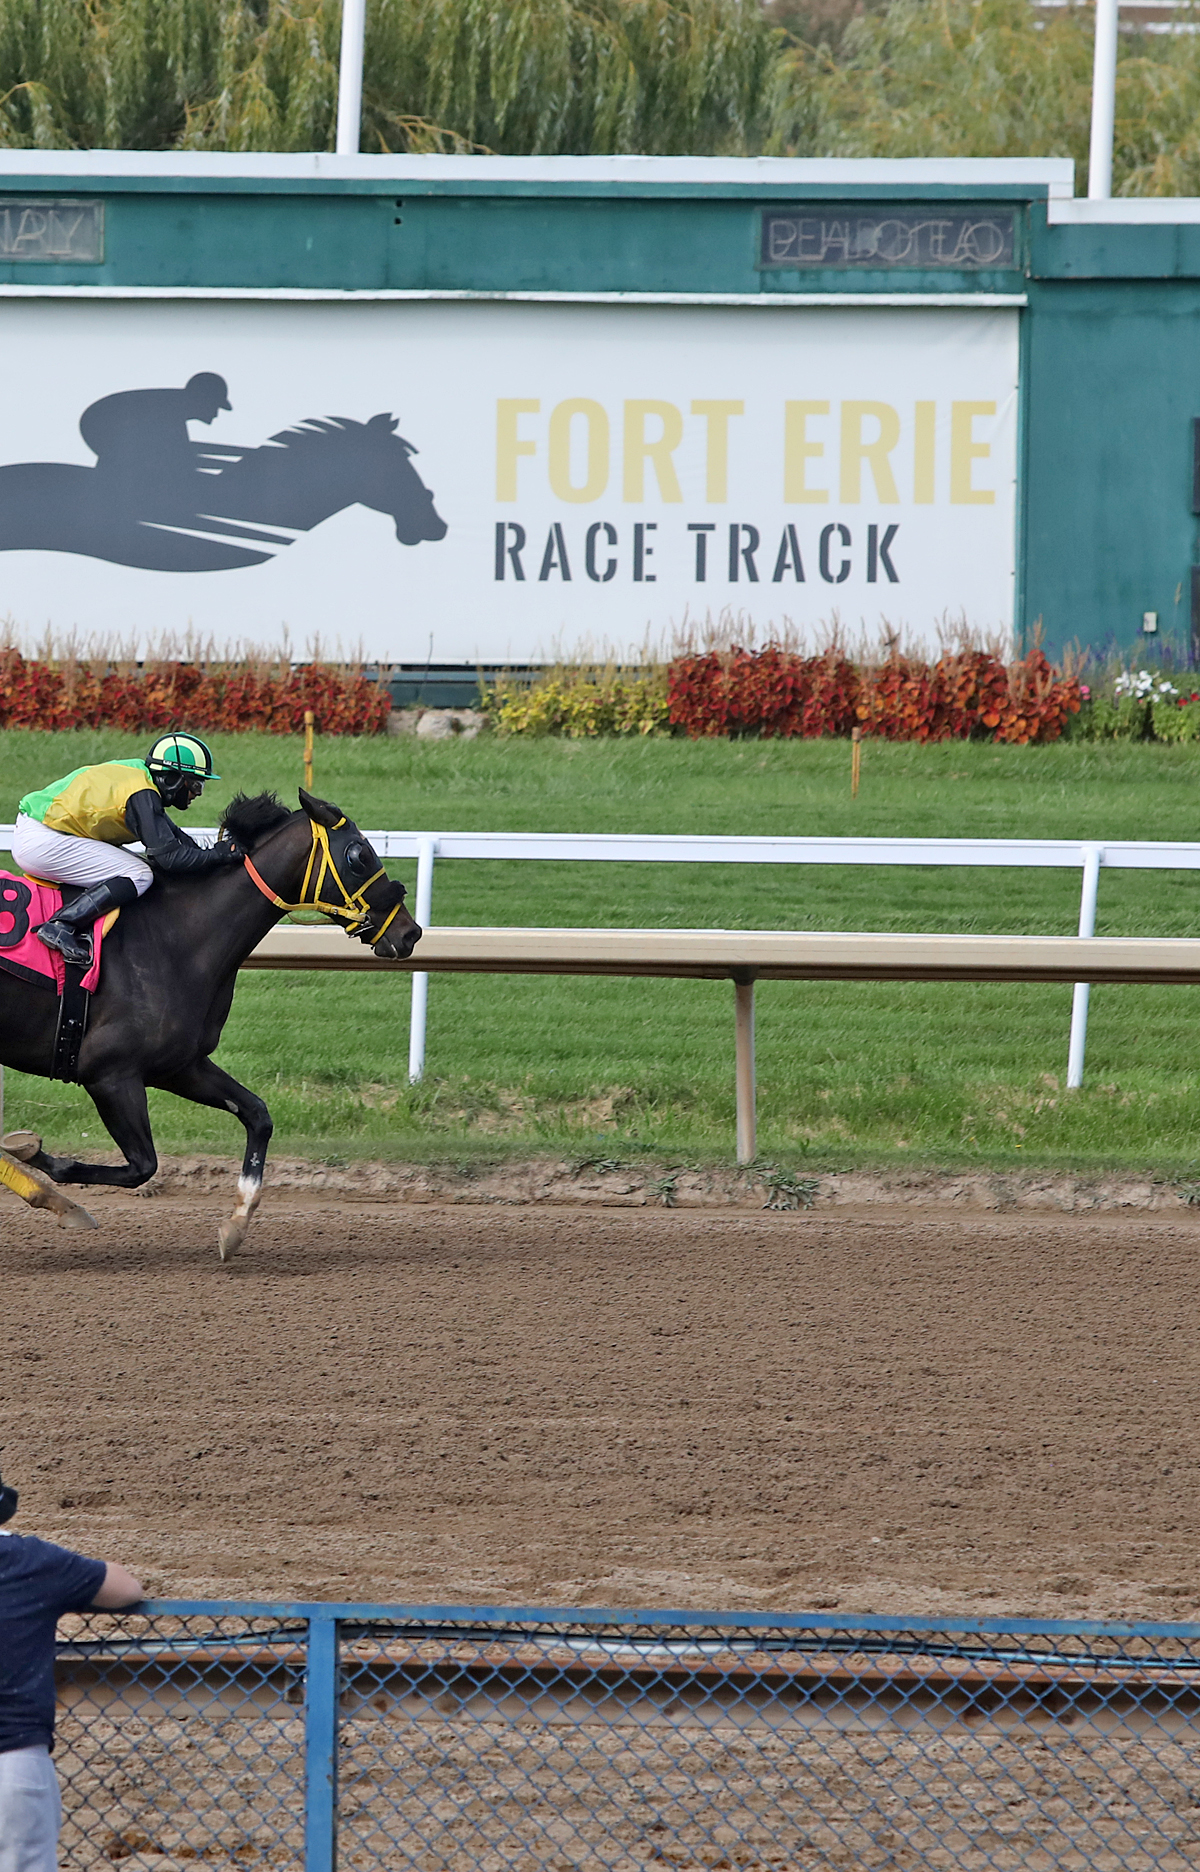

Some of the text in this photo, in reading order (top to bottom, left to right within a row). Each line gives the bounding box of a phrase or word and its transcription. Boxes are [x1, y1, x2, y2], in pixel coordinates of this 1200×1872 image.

[495, 397, 997, 505] FORT ERIE
[495, 522, 901, 584] RACE TRACK
